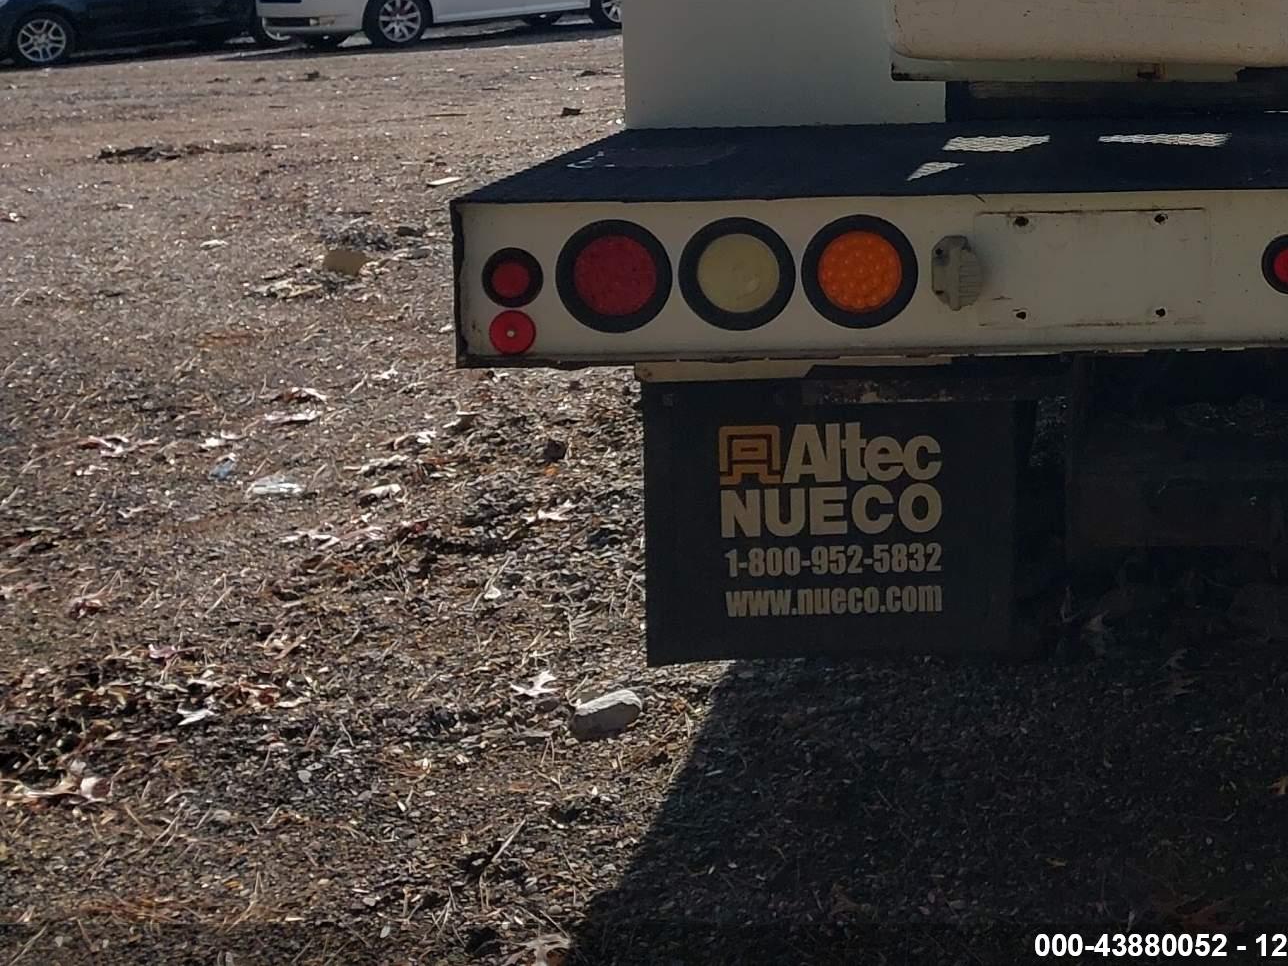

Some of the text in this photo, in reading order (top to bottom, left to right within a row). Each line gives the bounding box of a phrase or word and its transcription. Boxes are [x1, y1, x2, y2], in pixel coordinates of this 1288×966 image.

[783, 421, 942, 484] Altec
[720, 483, 942, 538] NUECO
[725, 542, 942, 577] 1-800-952-5832
[725, 586, 943, 617] www.nueco.com
